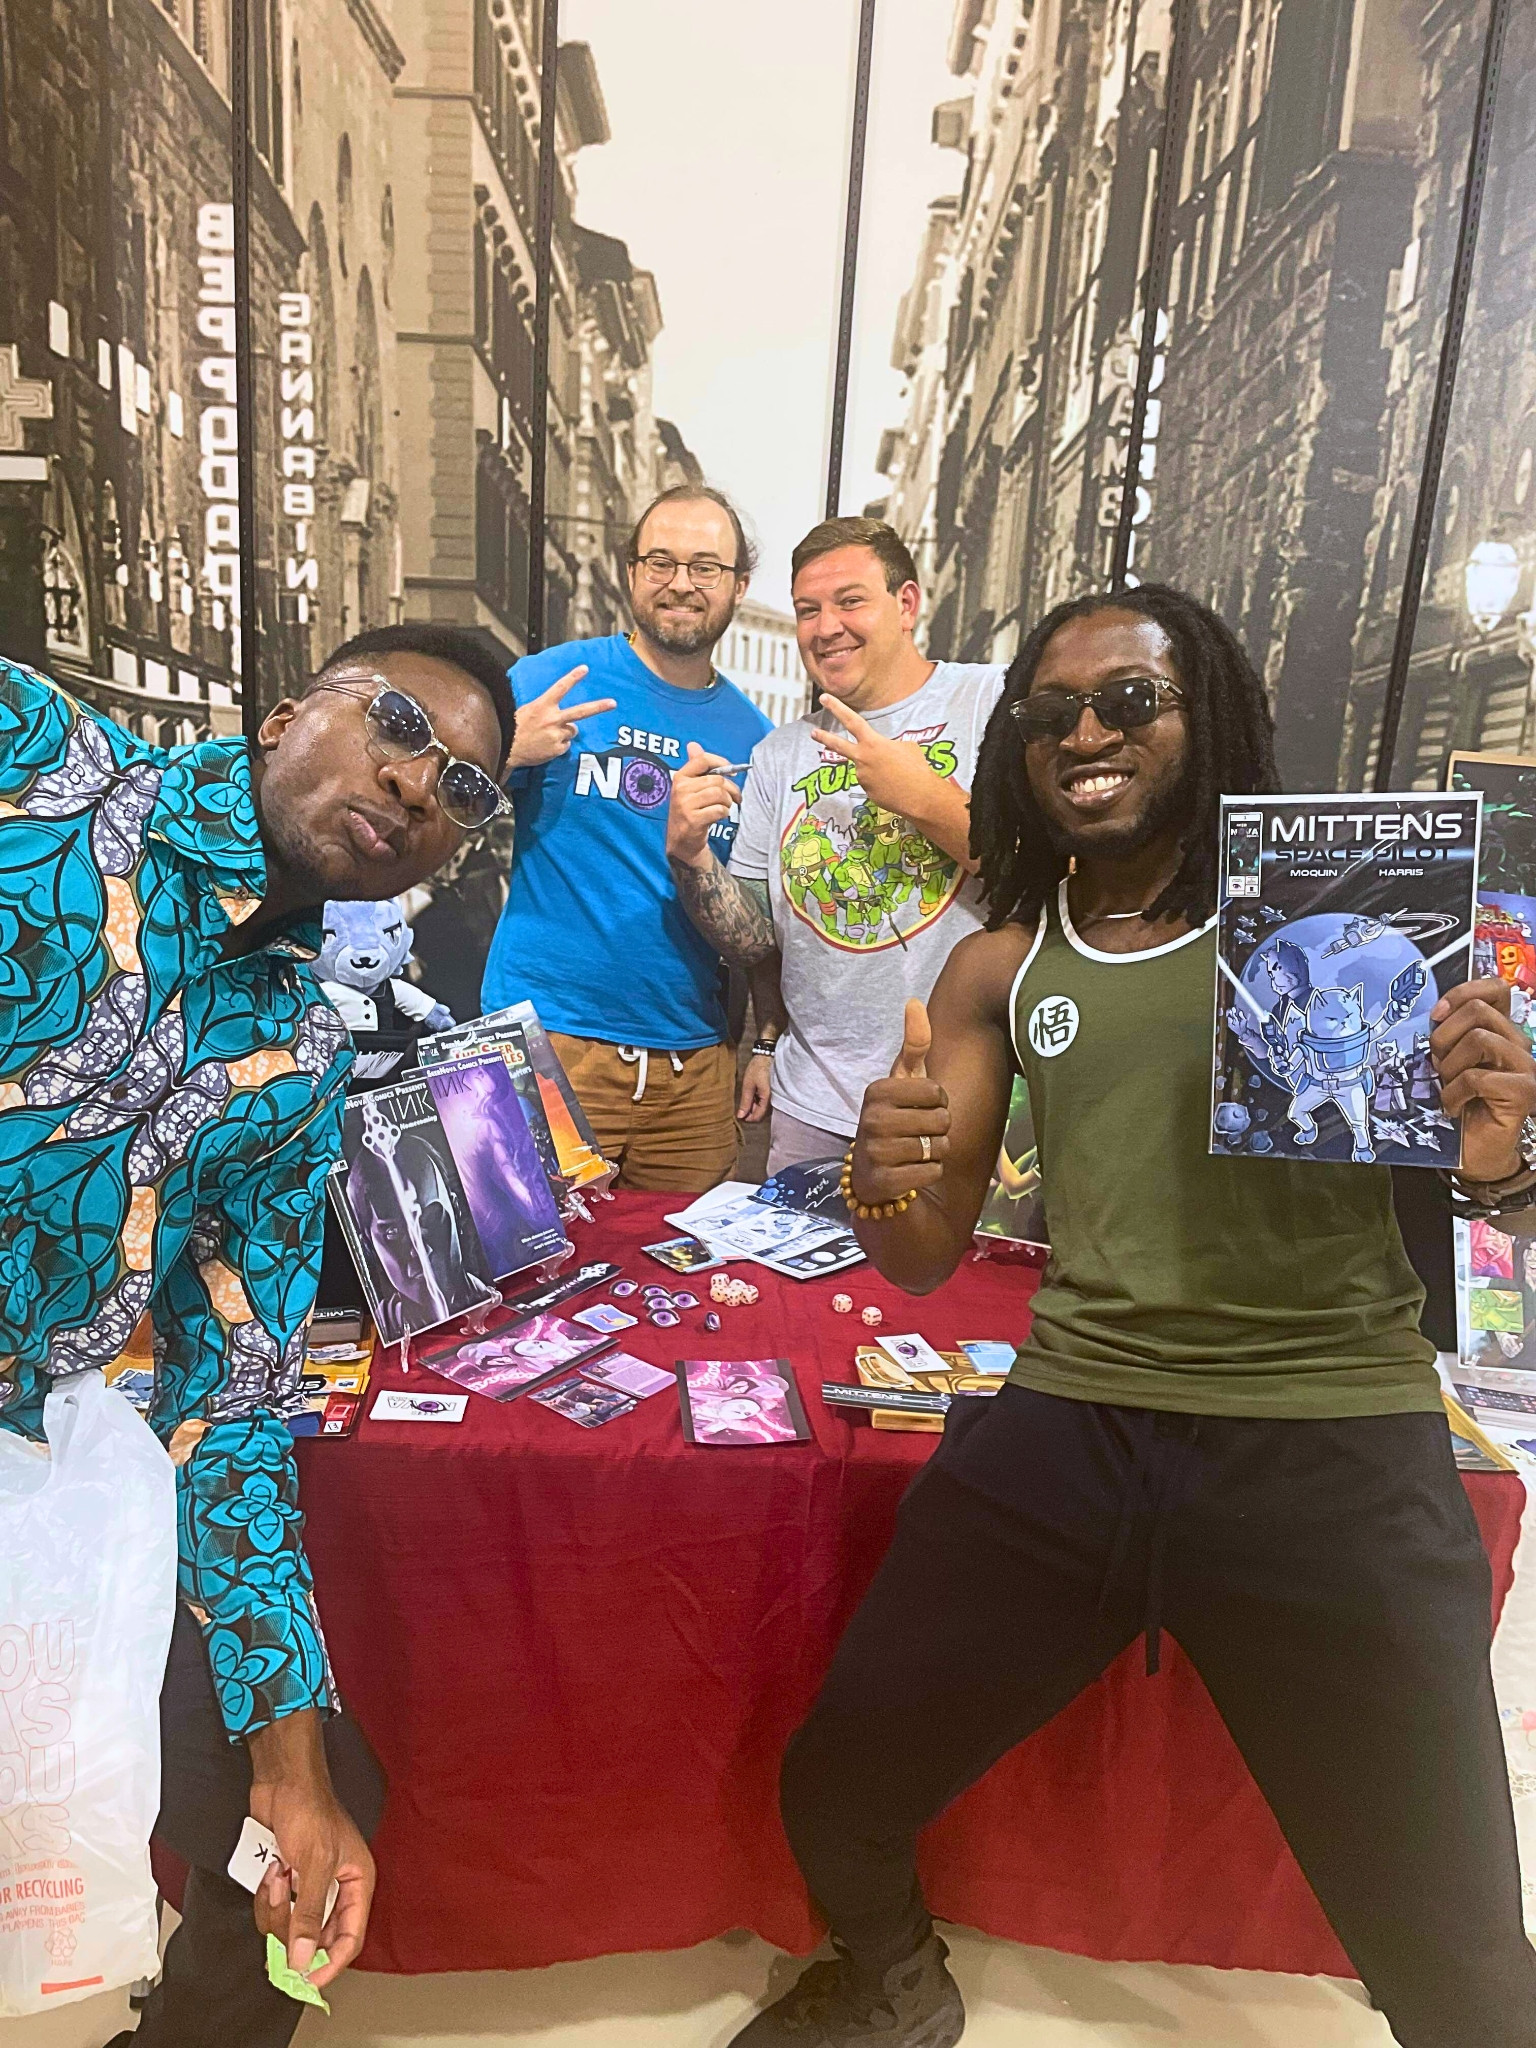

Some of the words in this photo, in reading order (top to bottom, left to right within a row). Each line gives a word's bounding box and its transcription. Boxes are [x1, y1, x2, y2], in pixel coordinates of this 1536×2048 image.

[617, 725, 680, 758] SEER
[1270, 812, 1464, 843] MITTENS
[1275, 847, 1363, 863] SPACE
[1373, 845, 1456, 862] PILOT
[1290, 869, 1338, 877] MOQUIN
[1378, 868, 1424, 877] HARRIS
[1033, 1000, 1074, 1050] 悟
[16, 1877, 85, 1900] RECYCLING
[29, 1905, 54, 1916] FROM
